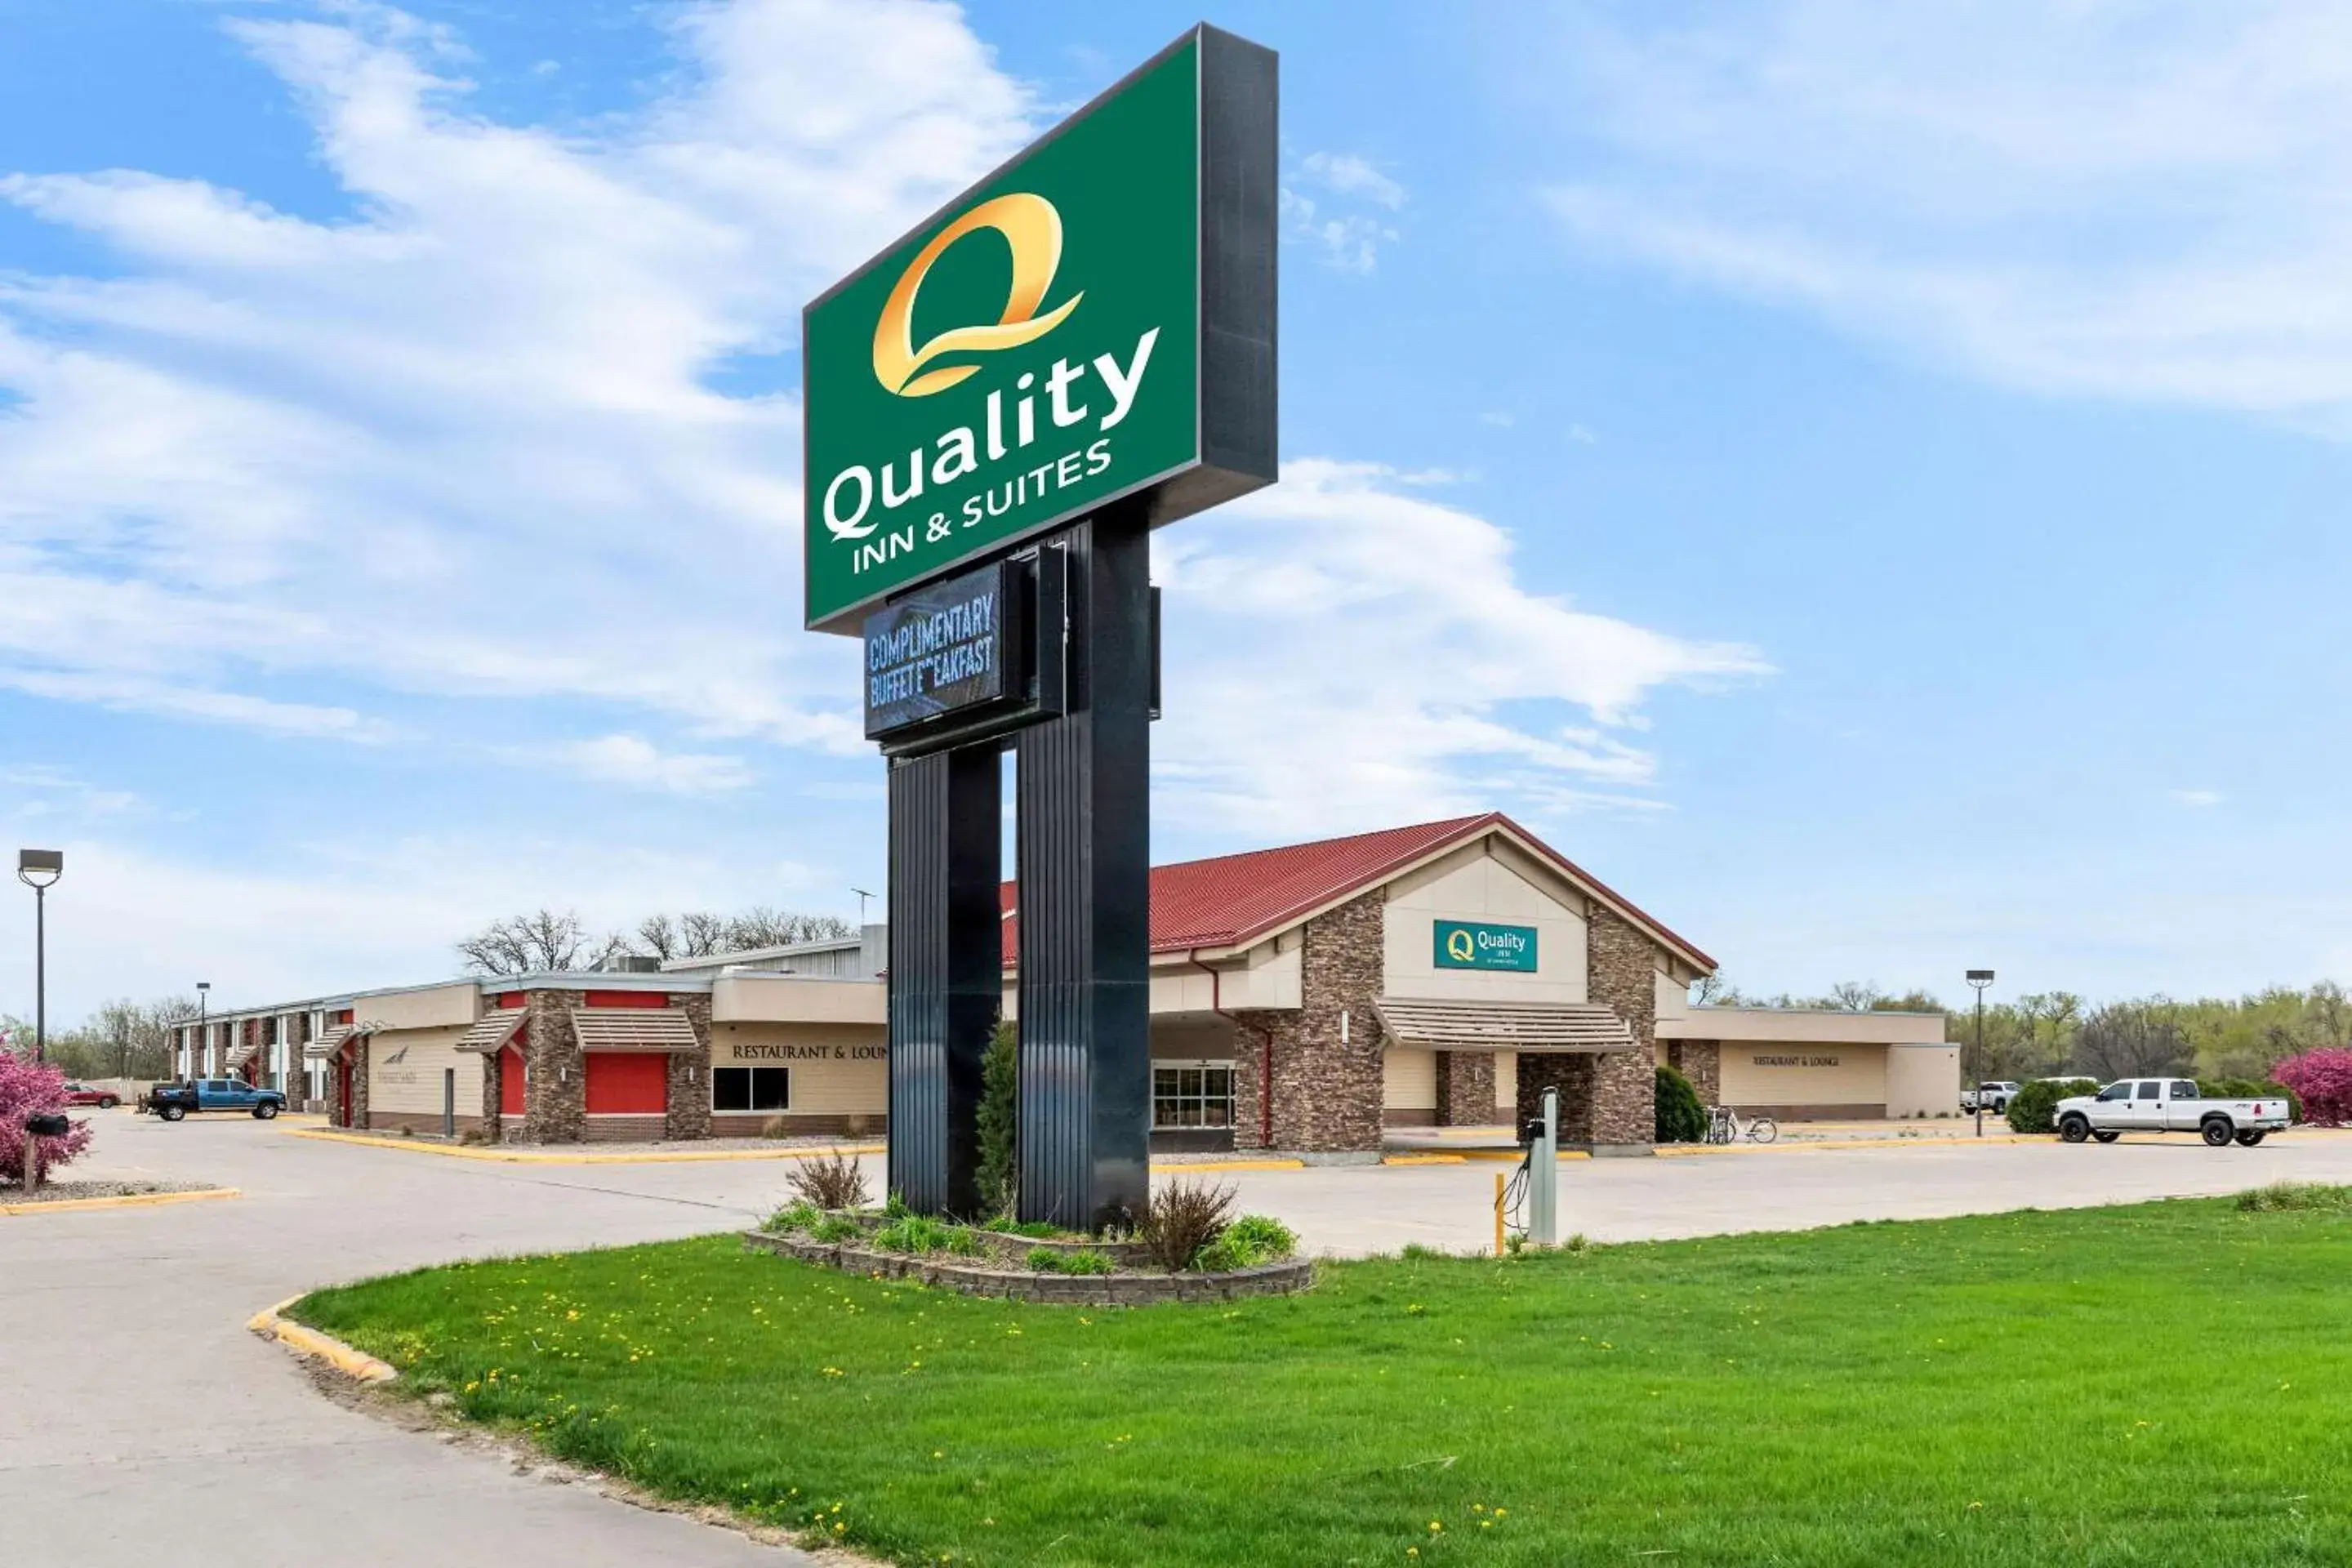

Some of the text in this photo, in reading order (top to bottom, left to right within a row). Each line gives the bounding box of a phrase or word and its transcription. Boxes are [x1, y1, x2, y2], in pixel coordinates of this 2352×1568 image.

[822, 326, 1161, 543] Quality
[853, 438, 1112, 574] INN & SUITES
[870, 592, 993, 671] COMPLIMENTARY
[871, 663, 913, 708] BUFFET
[1477, 930, 1526, 952] Quality
[733, 1044, 831, 1060] RESTAURANT
[834, 1045, 845, 1059] &
